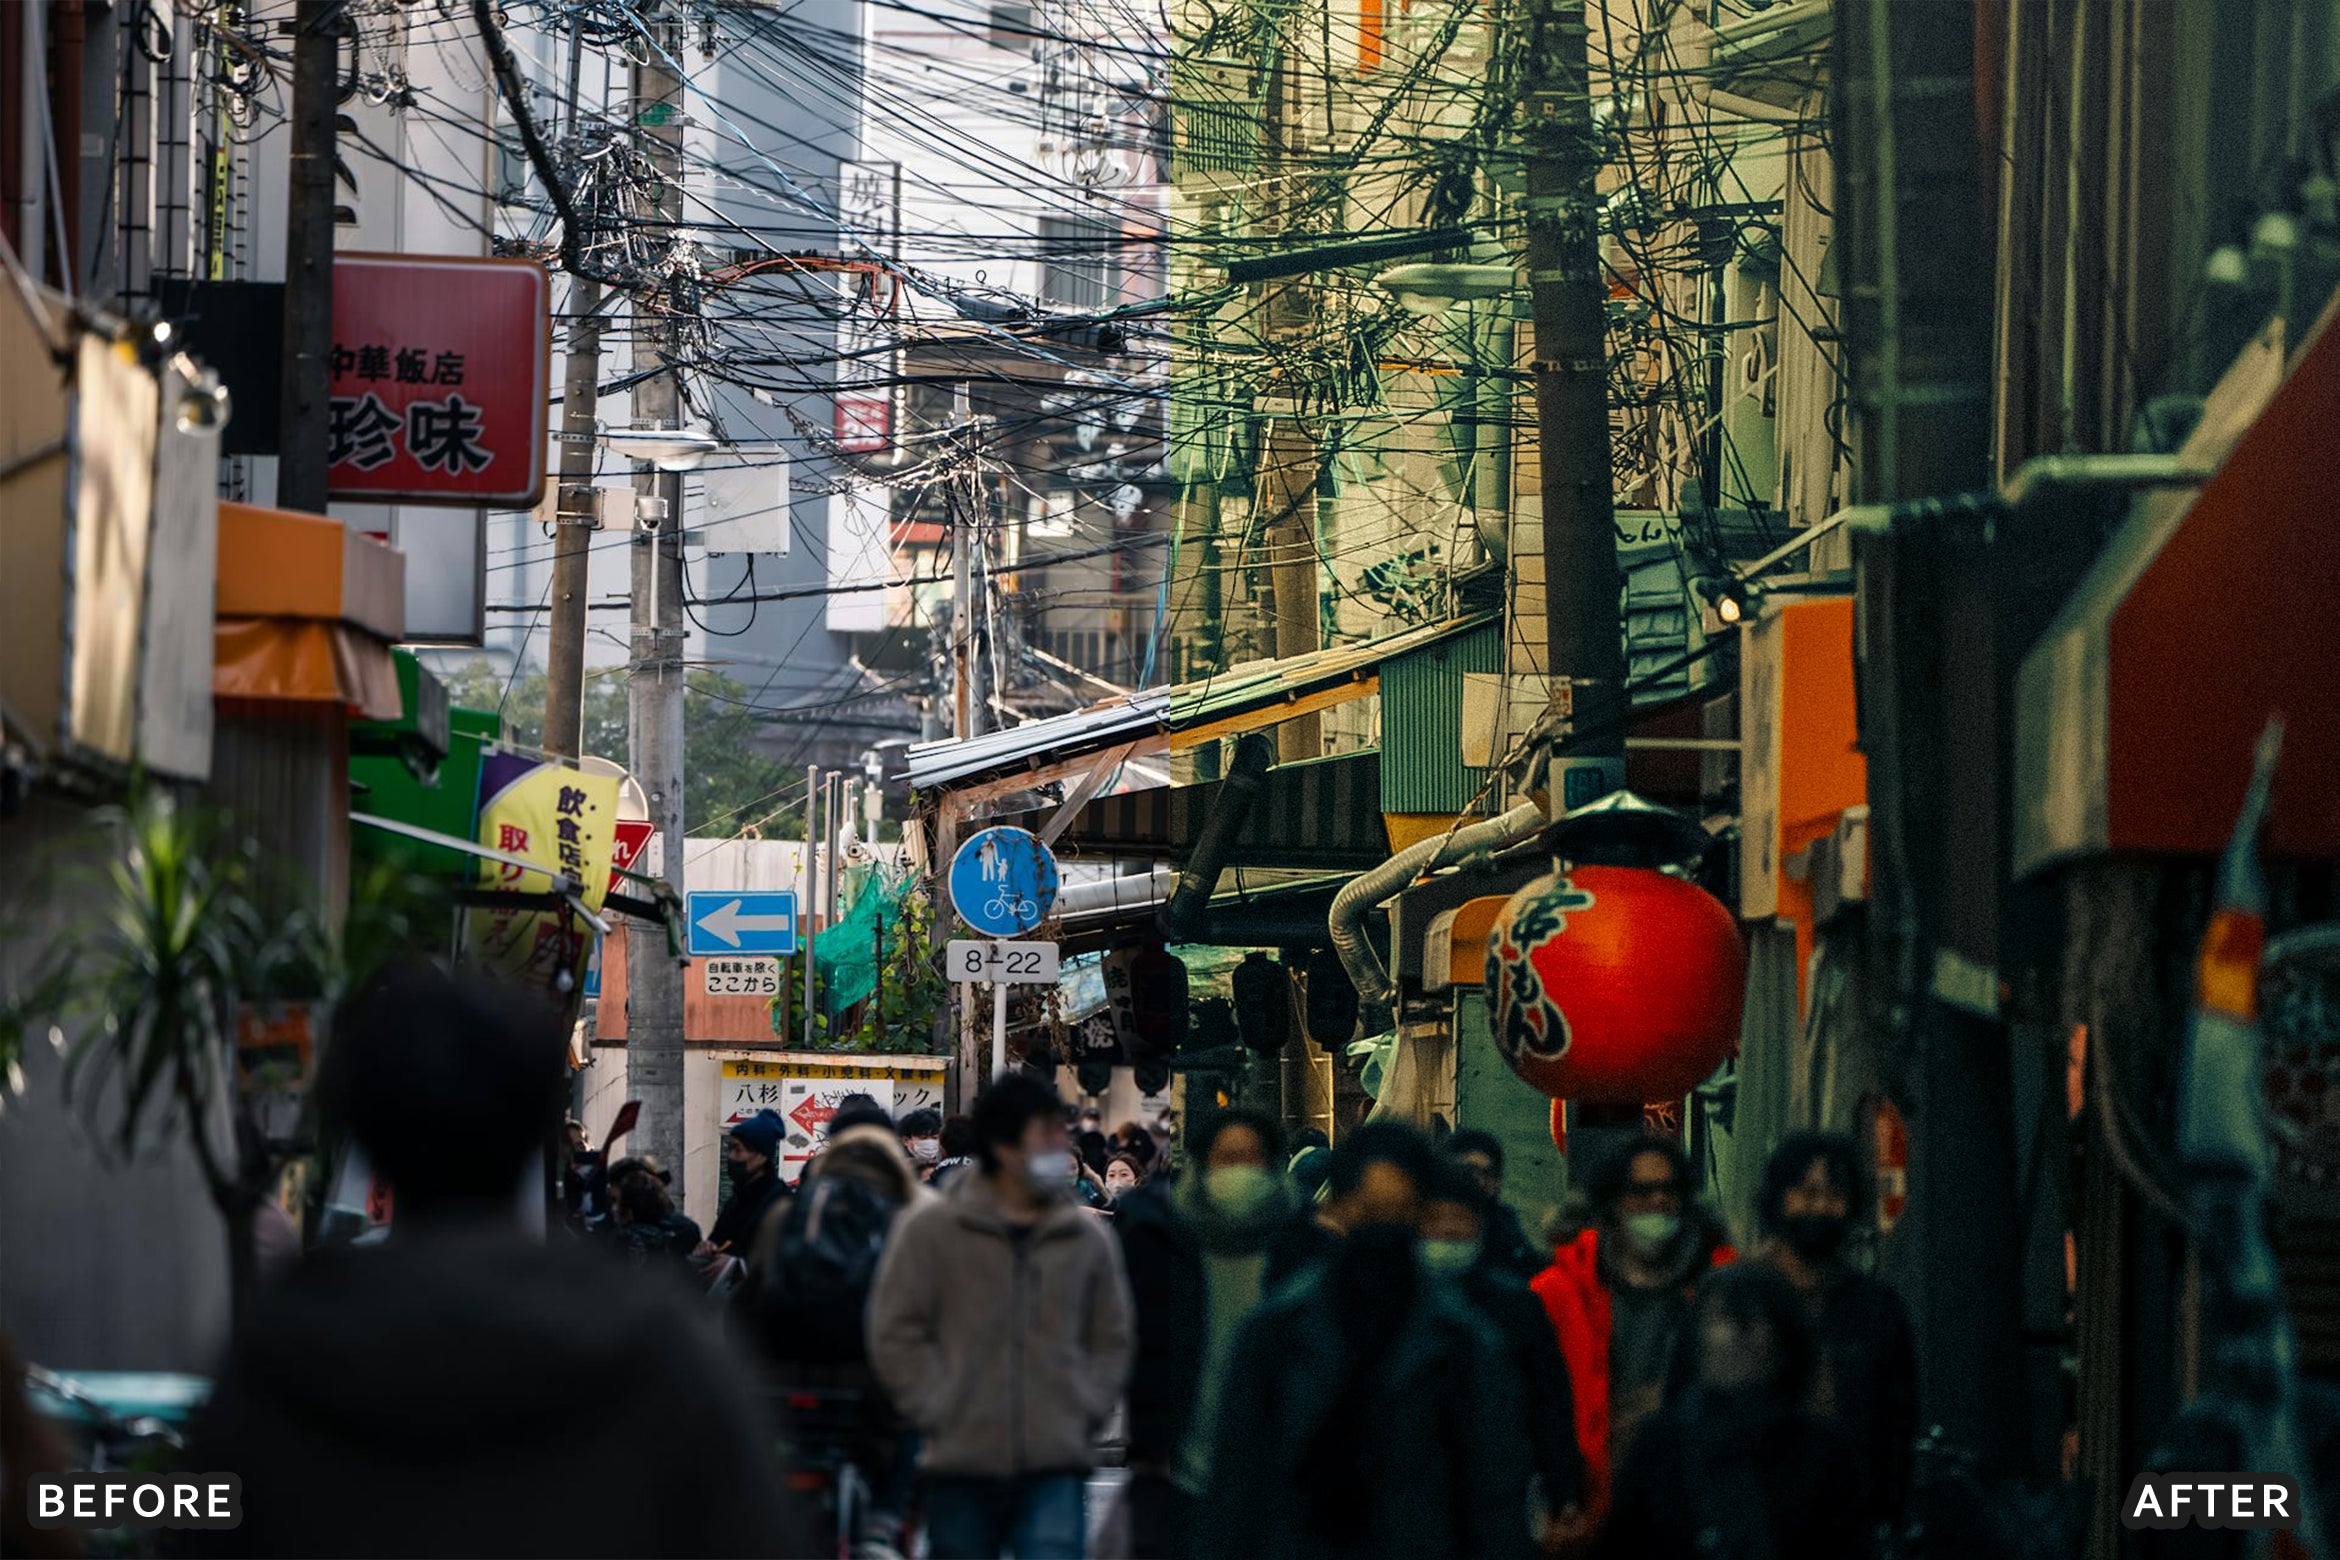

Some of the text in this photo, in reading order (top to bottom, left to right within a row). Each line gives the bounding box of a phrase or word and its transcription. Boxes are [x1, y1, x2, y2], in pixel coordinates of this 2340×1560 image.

[331, 344, 464, 386] 中華飯店
[329, 393, 493, 475] 珍味
[708, 962, 776, 974] 自転車を除く
[965, 950, 1041, 974] 8-22
[708, 977, 776, 993] ここから
[736, 1083, 779, 1105] 八杉
